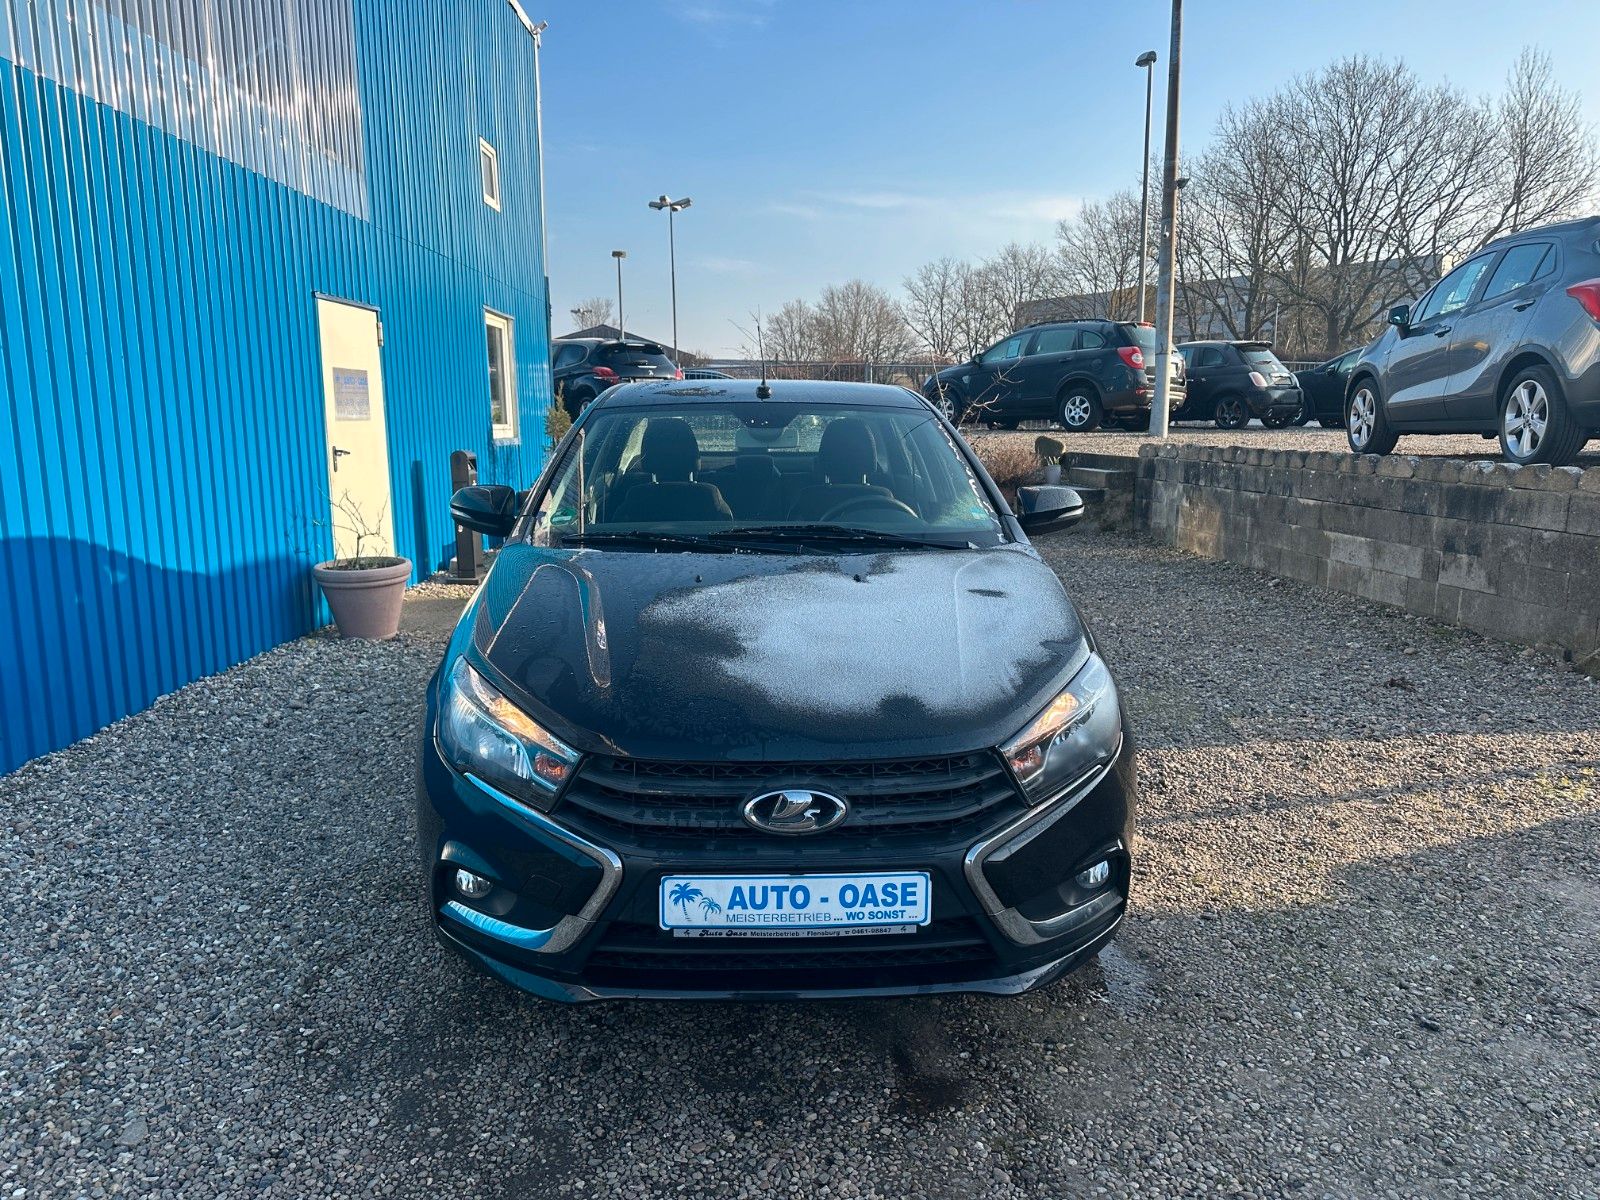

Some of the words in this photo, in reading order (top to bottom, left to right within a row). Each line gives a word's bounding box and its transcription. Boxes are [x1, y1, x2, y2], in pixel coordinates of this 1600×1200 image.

[727, 885, 810, 910] AUTO
[838, 883, 918, 909] OASE
[726, 913, 831, 923] MEISTERBETRIEB
[846, 911, 866, 921] WO
[868, 910, 906, 920] SONST
